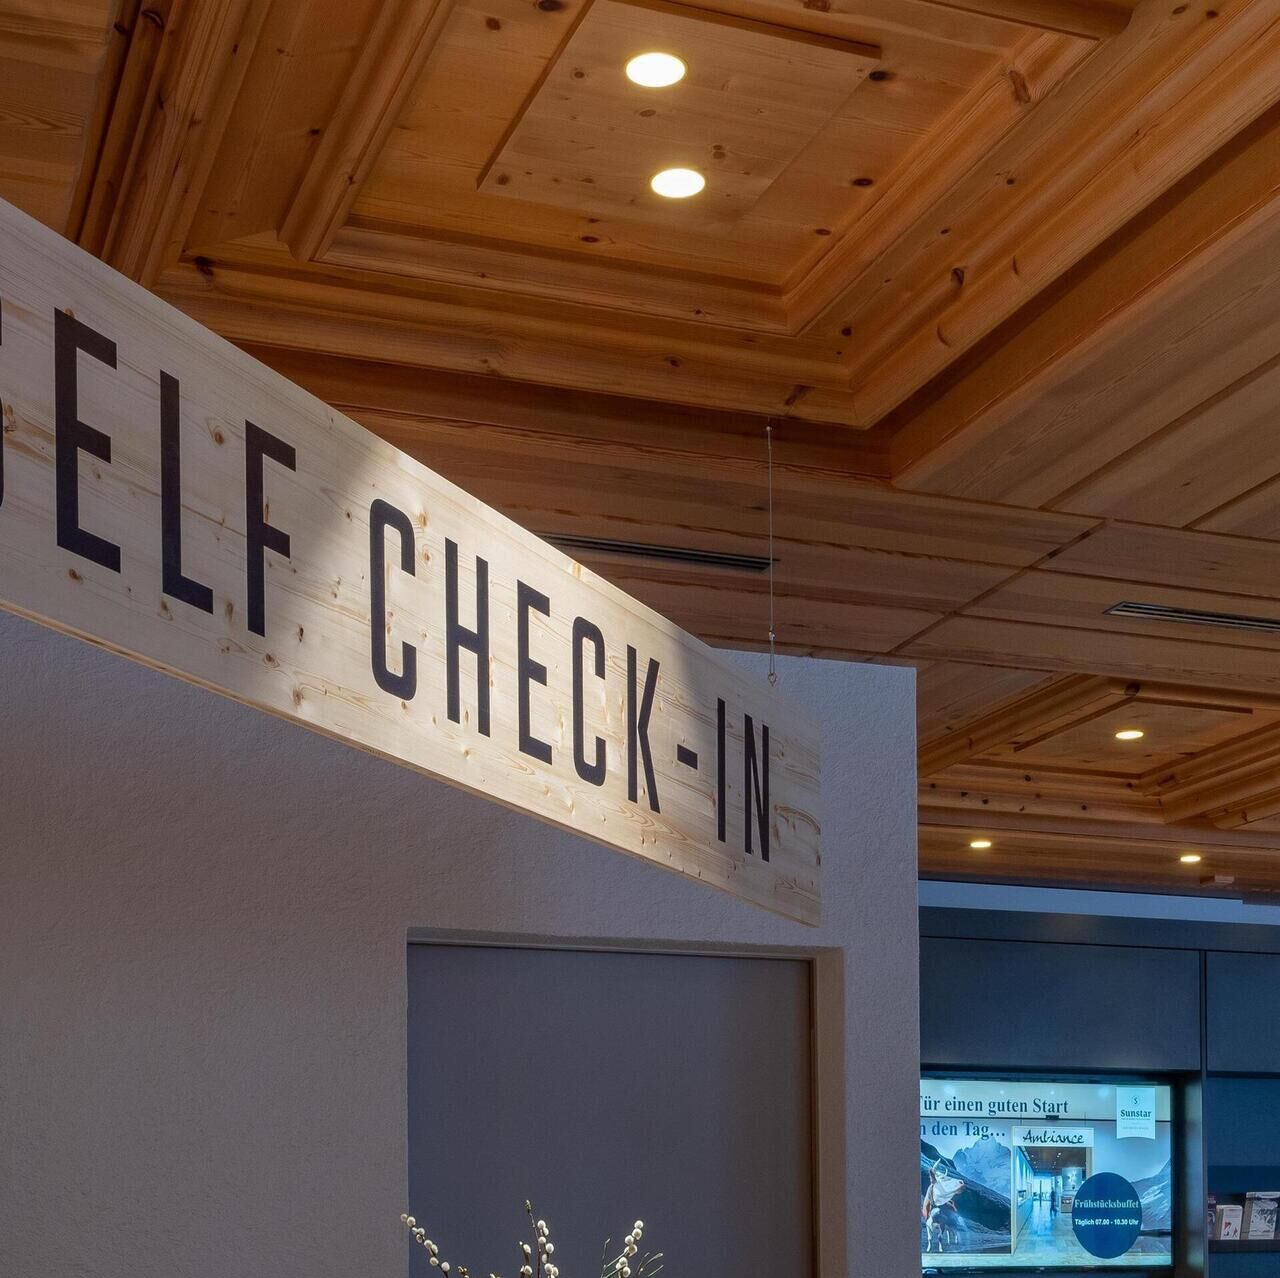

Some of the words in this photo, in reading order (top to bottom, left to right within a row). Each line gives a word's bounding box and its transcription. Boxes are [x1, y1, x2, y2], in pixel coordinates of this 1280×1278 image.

[370, 498, 770, 862] CHECK-IN
[920, 1095, 940, 1111] ür
[944, 1096, 983, 1112] einen
[988, 1099, 1028, 1116] guten
[1032, 1098, 1068, 1113] Start
[1120, 1109, 1152, 1118] Sunstar
[931, 1121, 958, 1136] den
[1022, 1129, 1084, 1145] Ambiance
[1074, 1199, 1139, 1209] Frühstücksbuffet
